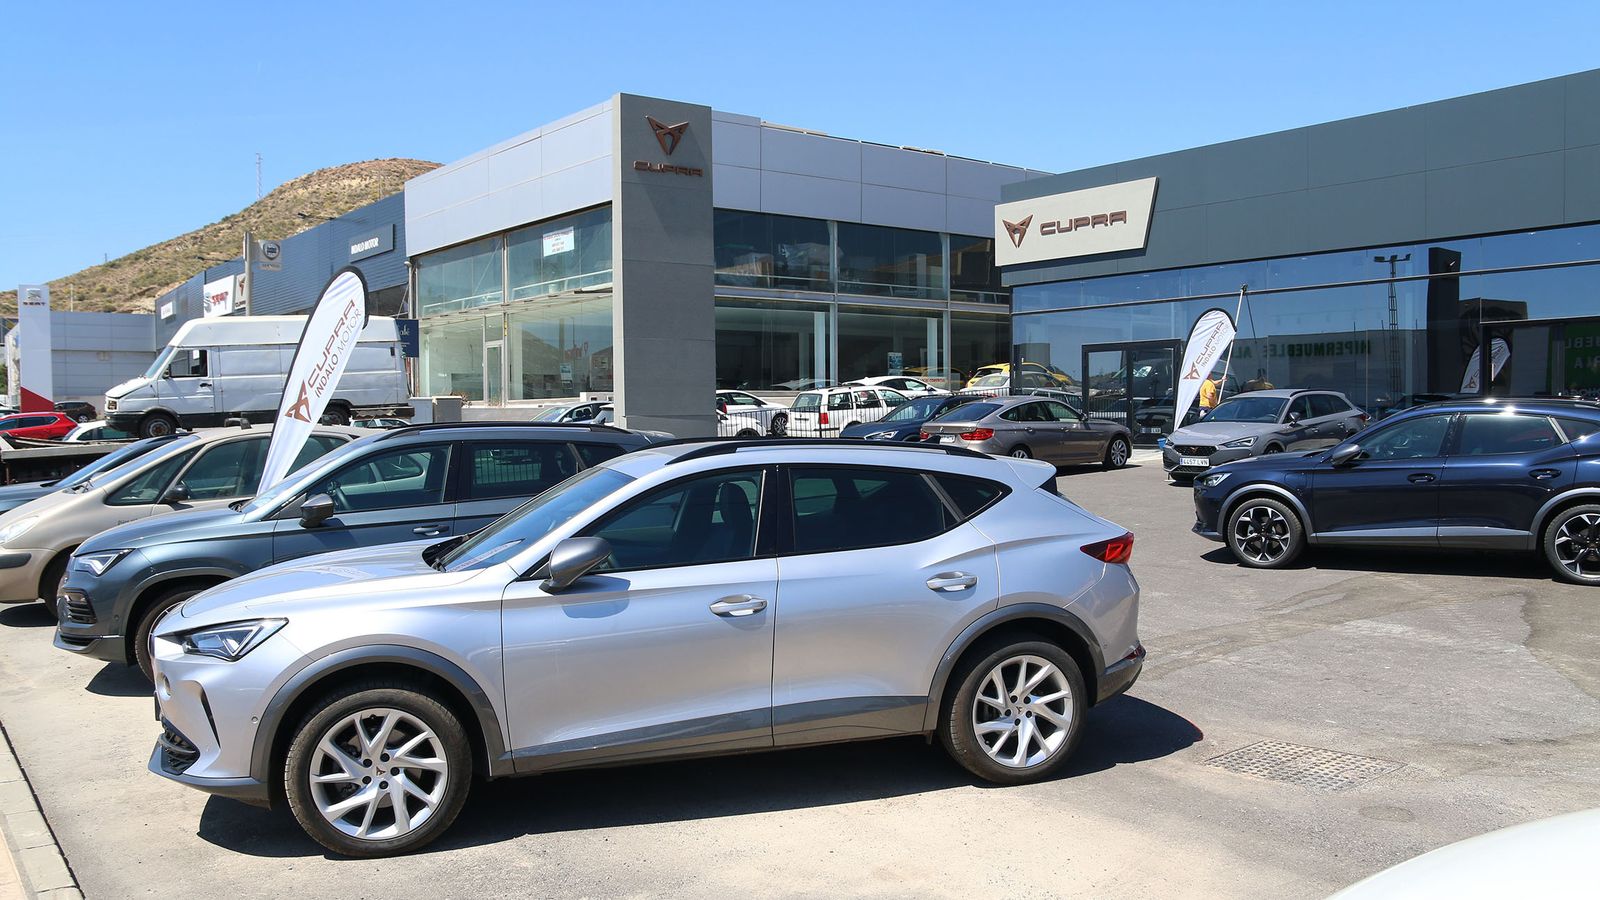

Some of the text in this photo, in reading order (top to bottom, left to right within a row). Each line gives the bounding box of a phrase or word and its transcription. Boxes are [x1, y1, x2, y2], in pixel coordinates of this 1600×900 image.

[633, 159, 704, 177] CUPRA
[1039, 210, 1127, 236] CUPRA
[307, 299, 356, 388] CUPRA
[314, 308, 362, 398] INDALO MOTOR
[1195, 320, 1225, 364] CUPRA
[1201, 346, 1217, 368] INDALO
